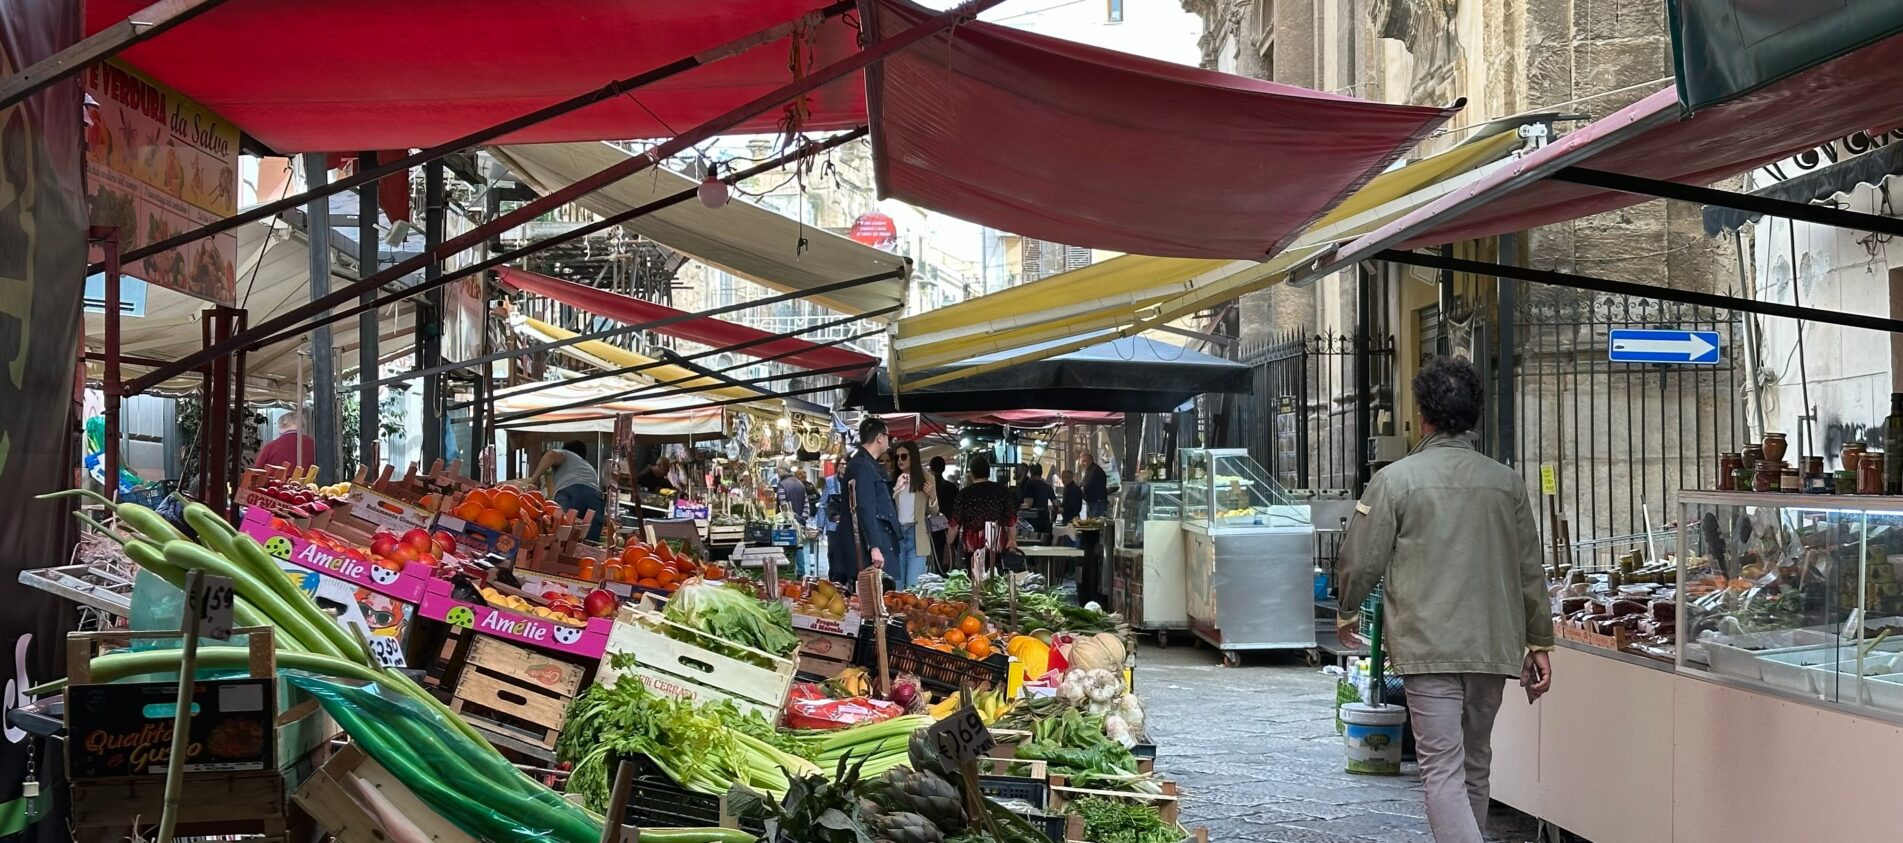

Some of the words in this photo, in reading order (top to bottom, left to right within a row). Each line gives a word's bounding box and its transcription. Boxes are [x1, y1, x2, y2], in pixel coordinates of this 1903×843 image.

[89, 61, 99, 91] E
[102, 58, 167, 126] VERDURA
[170, 103, 188, 138] da
[191, 114, 229, 158] Salvo
[298, 543, 364, 578] Amélie
[481, 610, 546, 641] Amélie
